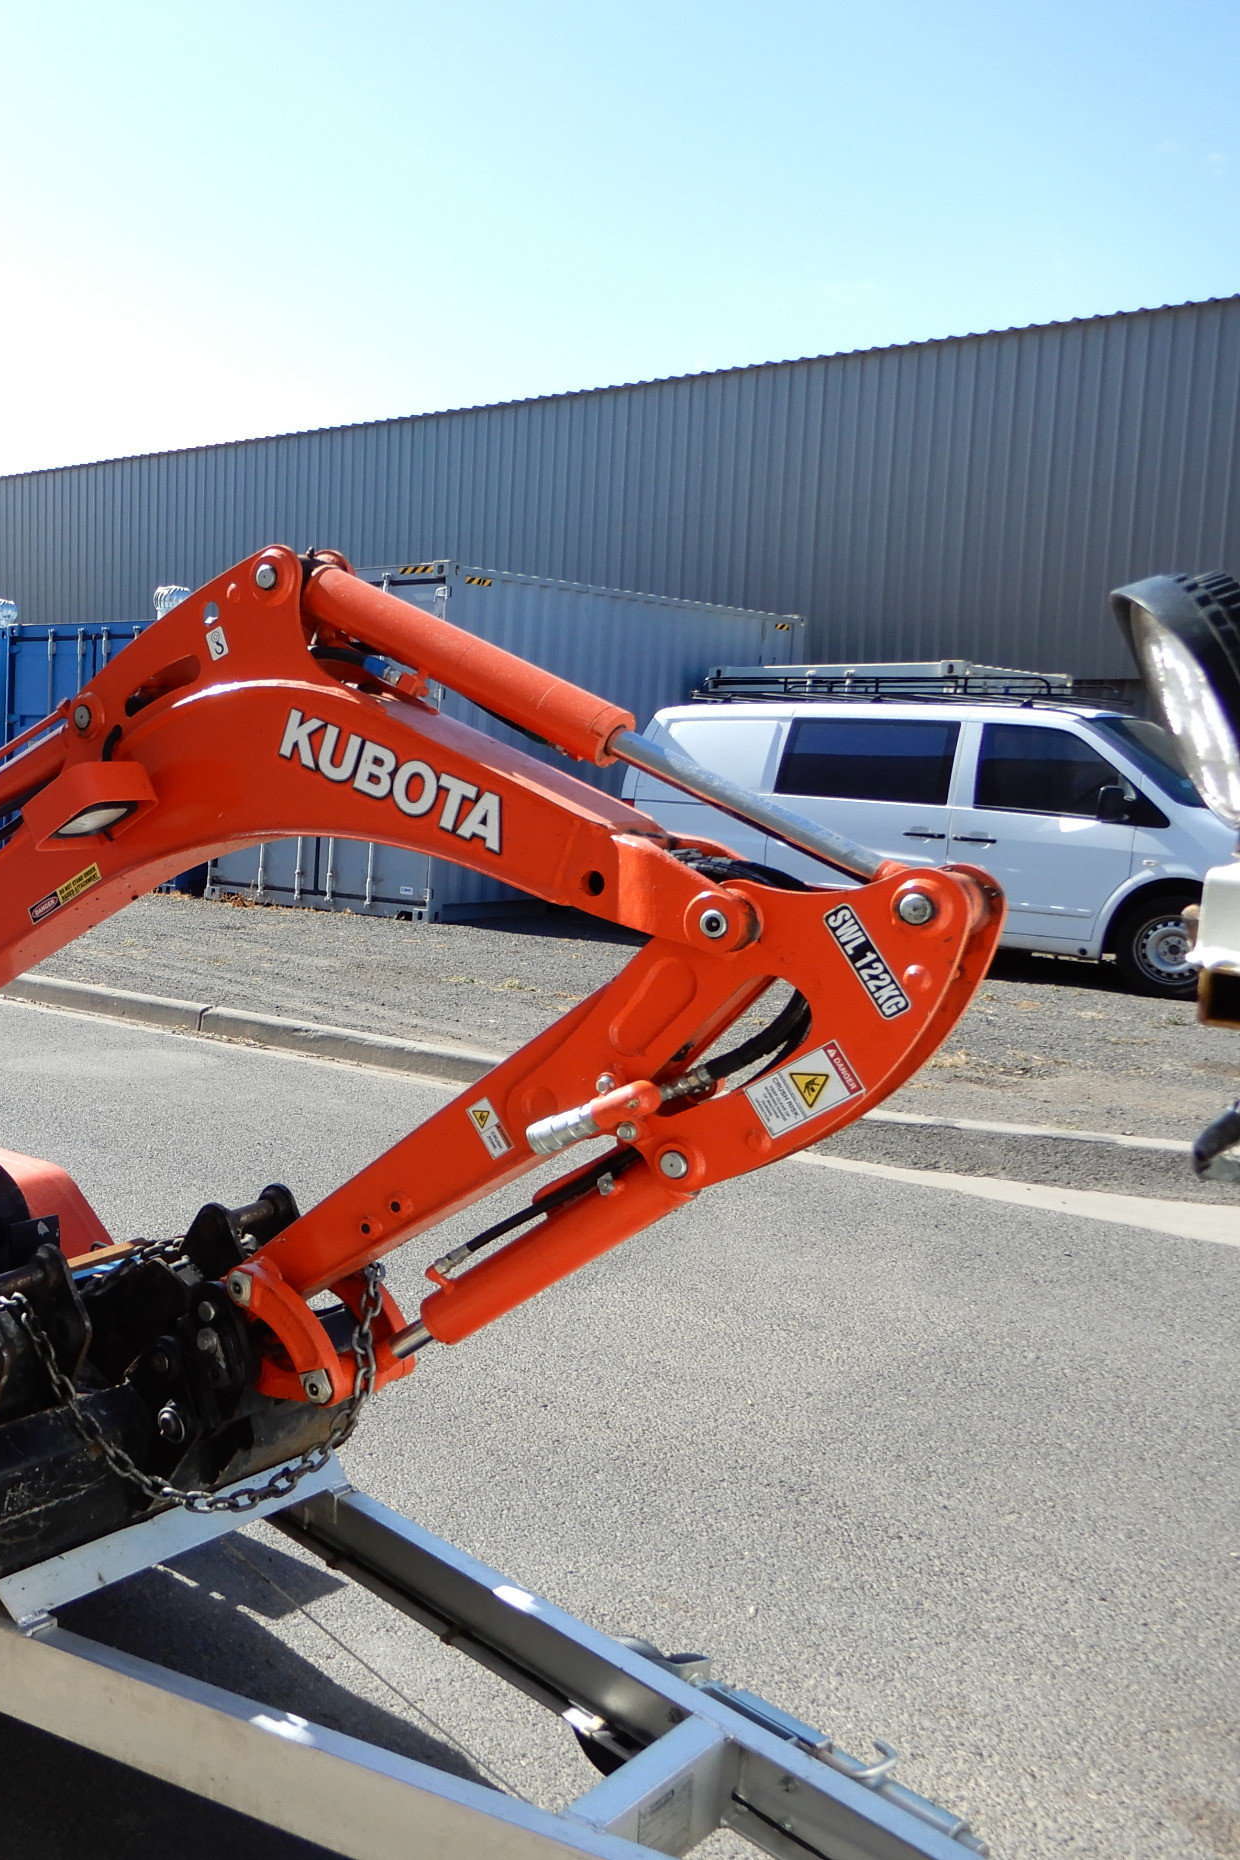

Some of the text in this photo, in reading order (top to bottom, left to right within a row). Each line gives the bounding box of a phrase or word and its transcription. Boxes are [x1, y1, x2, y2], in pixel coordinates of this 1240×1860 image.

[278, 708, 503, 855] KUBOTA
[72, 875, 84, 886] STAND
[35, 898, 55, 916] DANGER
[828, 909, 906, 1016] SWL 122KG
[833, 1056, 857, 1090] DANGER
[772, 1076, 790, 1102] CRUSH
